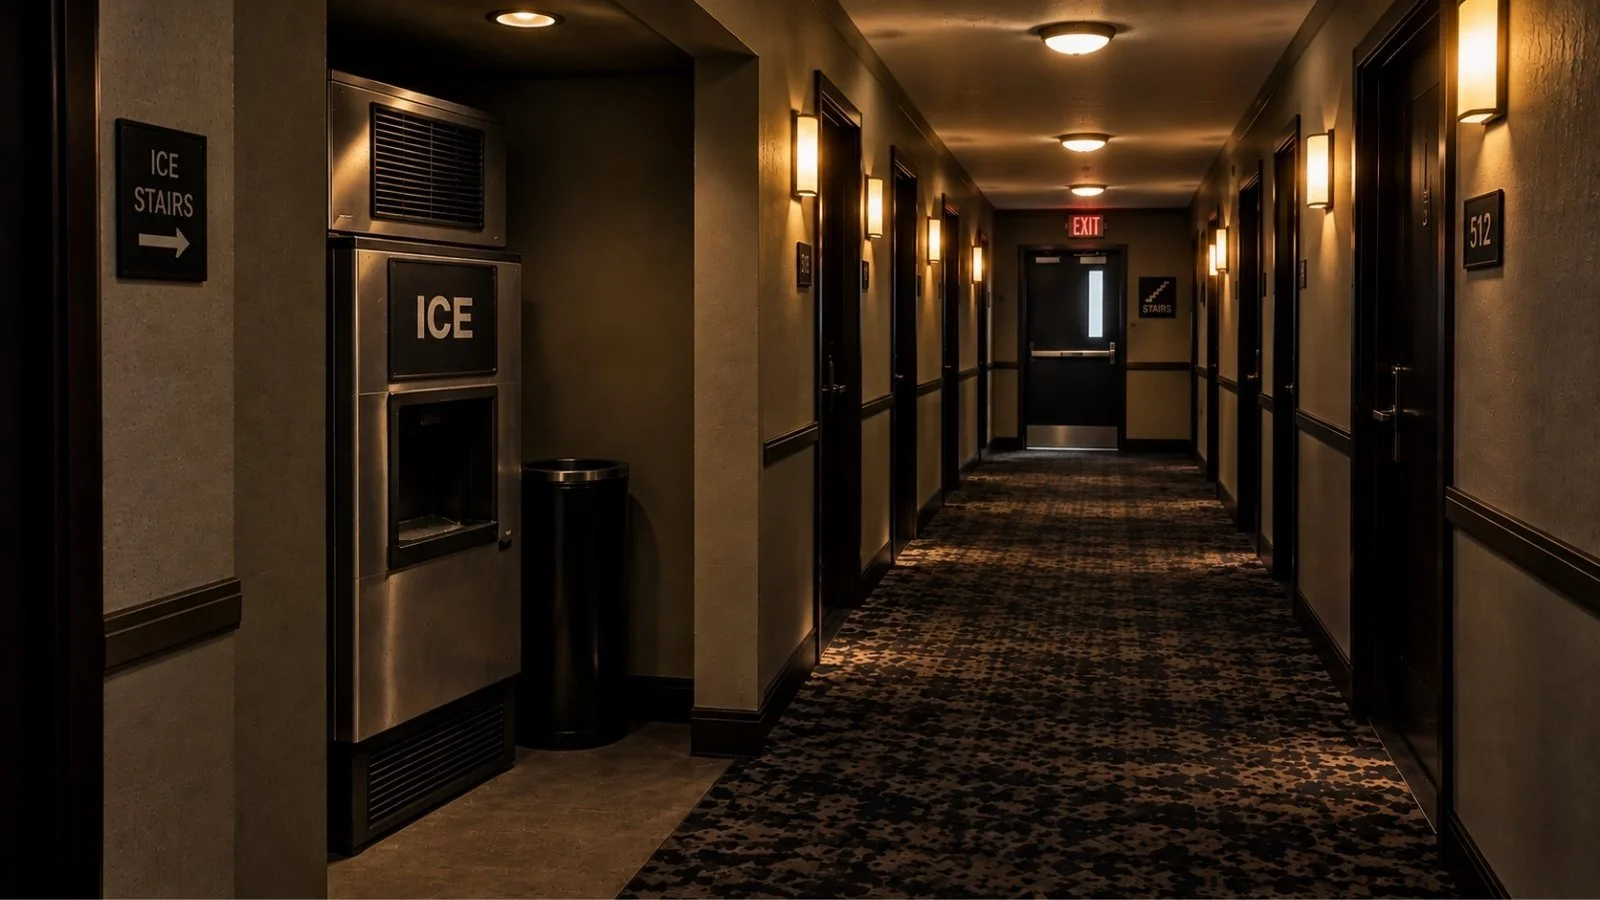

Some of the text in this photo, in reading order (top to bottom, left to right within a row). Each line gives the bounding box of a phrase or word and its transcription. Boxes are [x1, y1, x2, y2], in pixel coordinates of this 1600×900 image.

[151, 149, 179, 179] ICE
[134, 187, 194, 218] STAIRS
[1073, 216, 1101, 236] EXIT
[1470, 212, 1491, 249] 512
[417, 295, 473, 341] ICE
[1142, 304, 1172, 314] STAIRS
